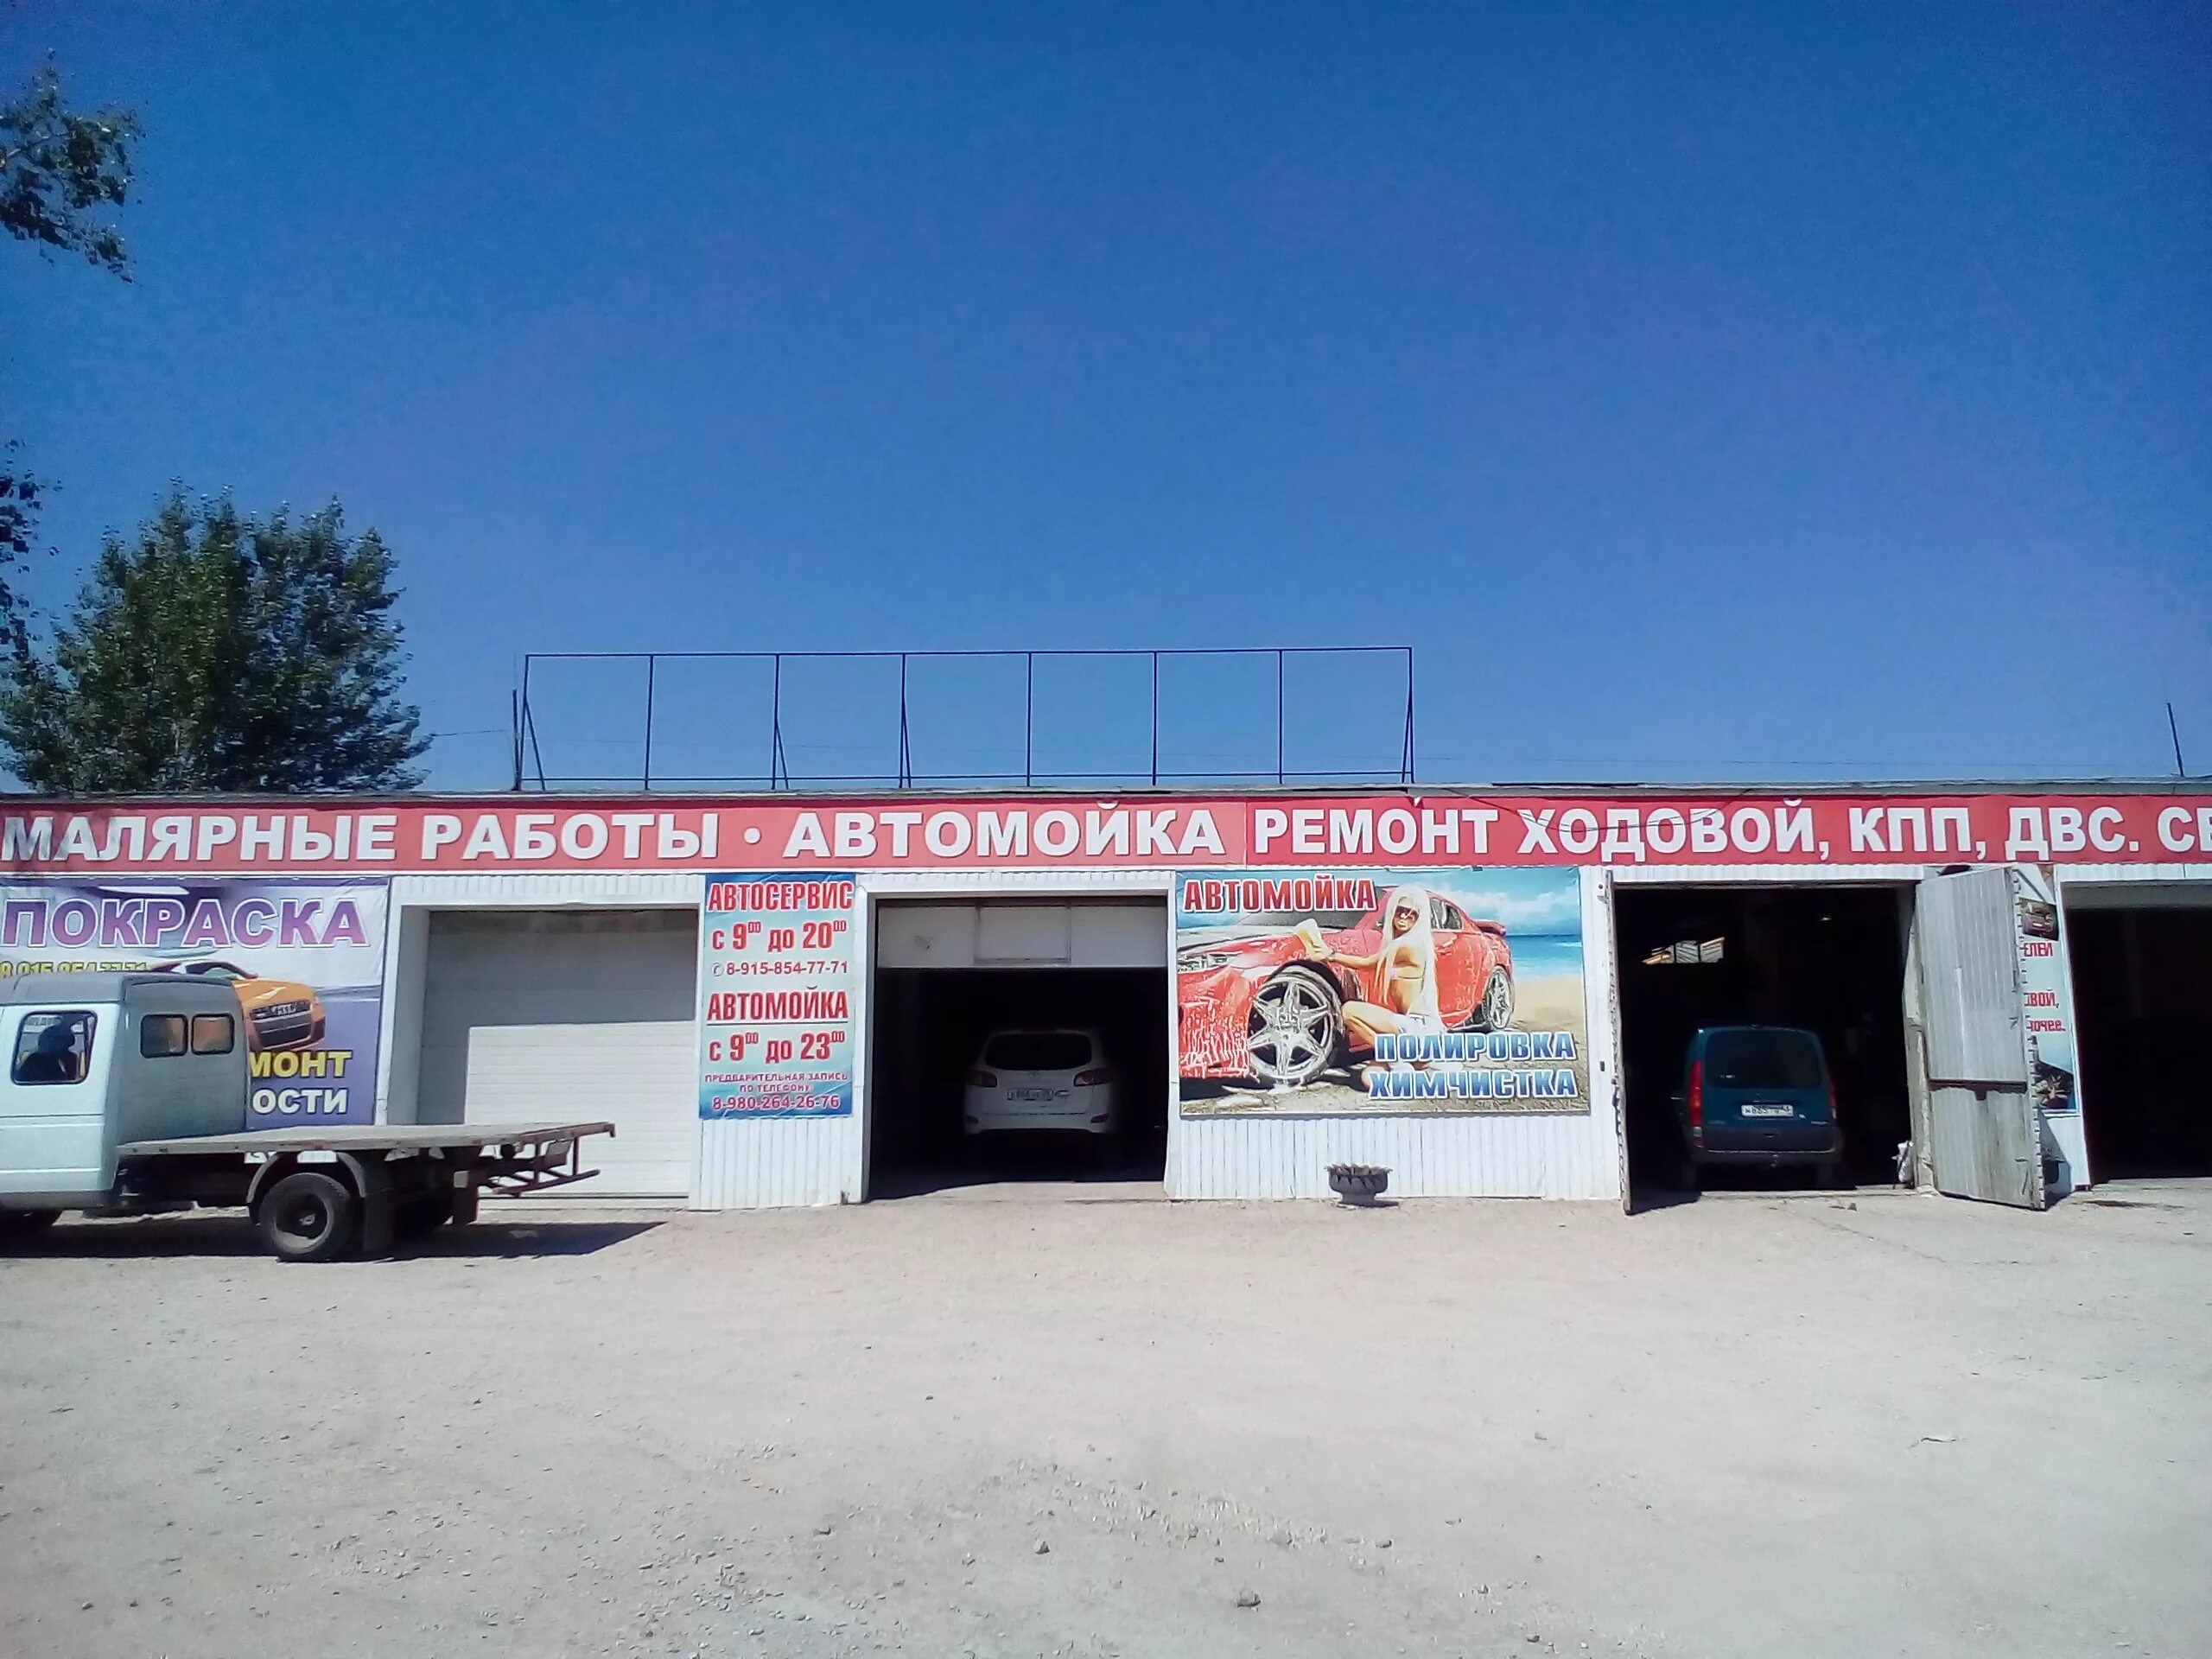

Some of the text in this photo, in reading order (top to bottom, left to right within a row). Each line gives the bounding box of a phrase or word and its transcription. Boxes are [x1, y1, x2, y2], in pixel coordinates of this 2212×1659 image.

[2, 800, 1226, 861] МАЛЯРНЫЕ РАБОТЫ АВТОМОЙКА
[1255, 808, 1498, 855] РЕМОНТ
[1517, 798, 1830, 861] ХОДОВОЙ,
[1849, 806, 1986, 858] КПП,
[2005, 806, 2139, 861] ДВС.
[708, 881, 854, 912] АВТОСЕРВИС
[1183, 874, 1378, 912] АВТОМОЙКА
[2, 898, 371, 948] ПОКРАСКА
[767, 929, 795, 953] до
[726, 960, 849, 976] 8-915-854-77-71
[707, 985, 849, 1021] АВТОМОЙКА
[766, 1039, 792, 1065] до
[1375, 1031, 1576, 1063] ПОЛИРОВКА
[249, 1050, 353, 1078] МОНТ
[705, 1071, 849, 1083] ПРЕДВАРИТЕЛЬНАЯ ЗАПИСЬ
[1368, 1068, 1577, 1100] ХИМЧИСТКА
[252, 1088, 349, 1115] ОСТИ
[712, 1095, 840, 1110] 8-980-264-26-76
